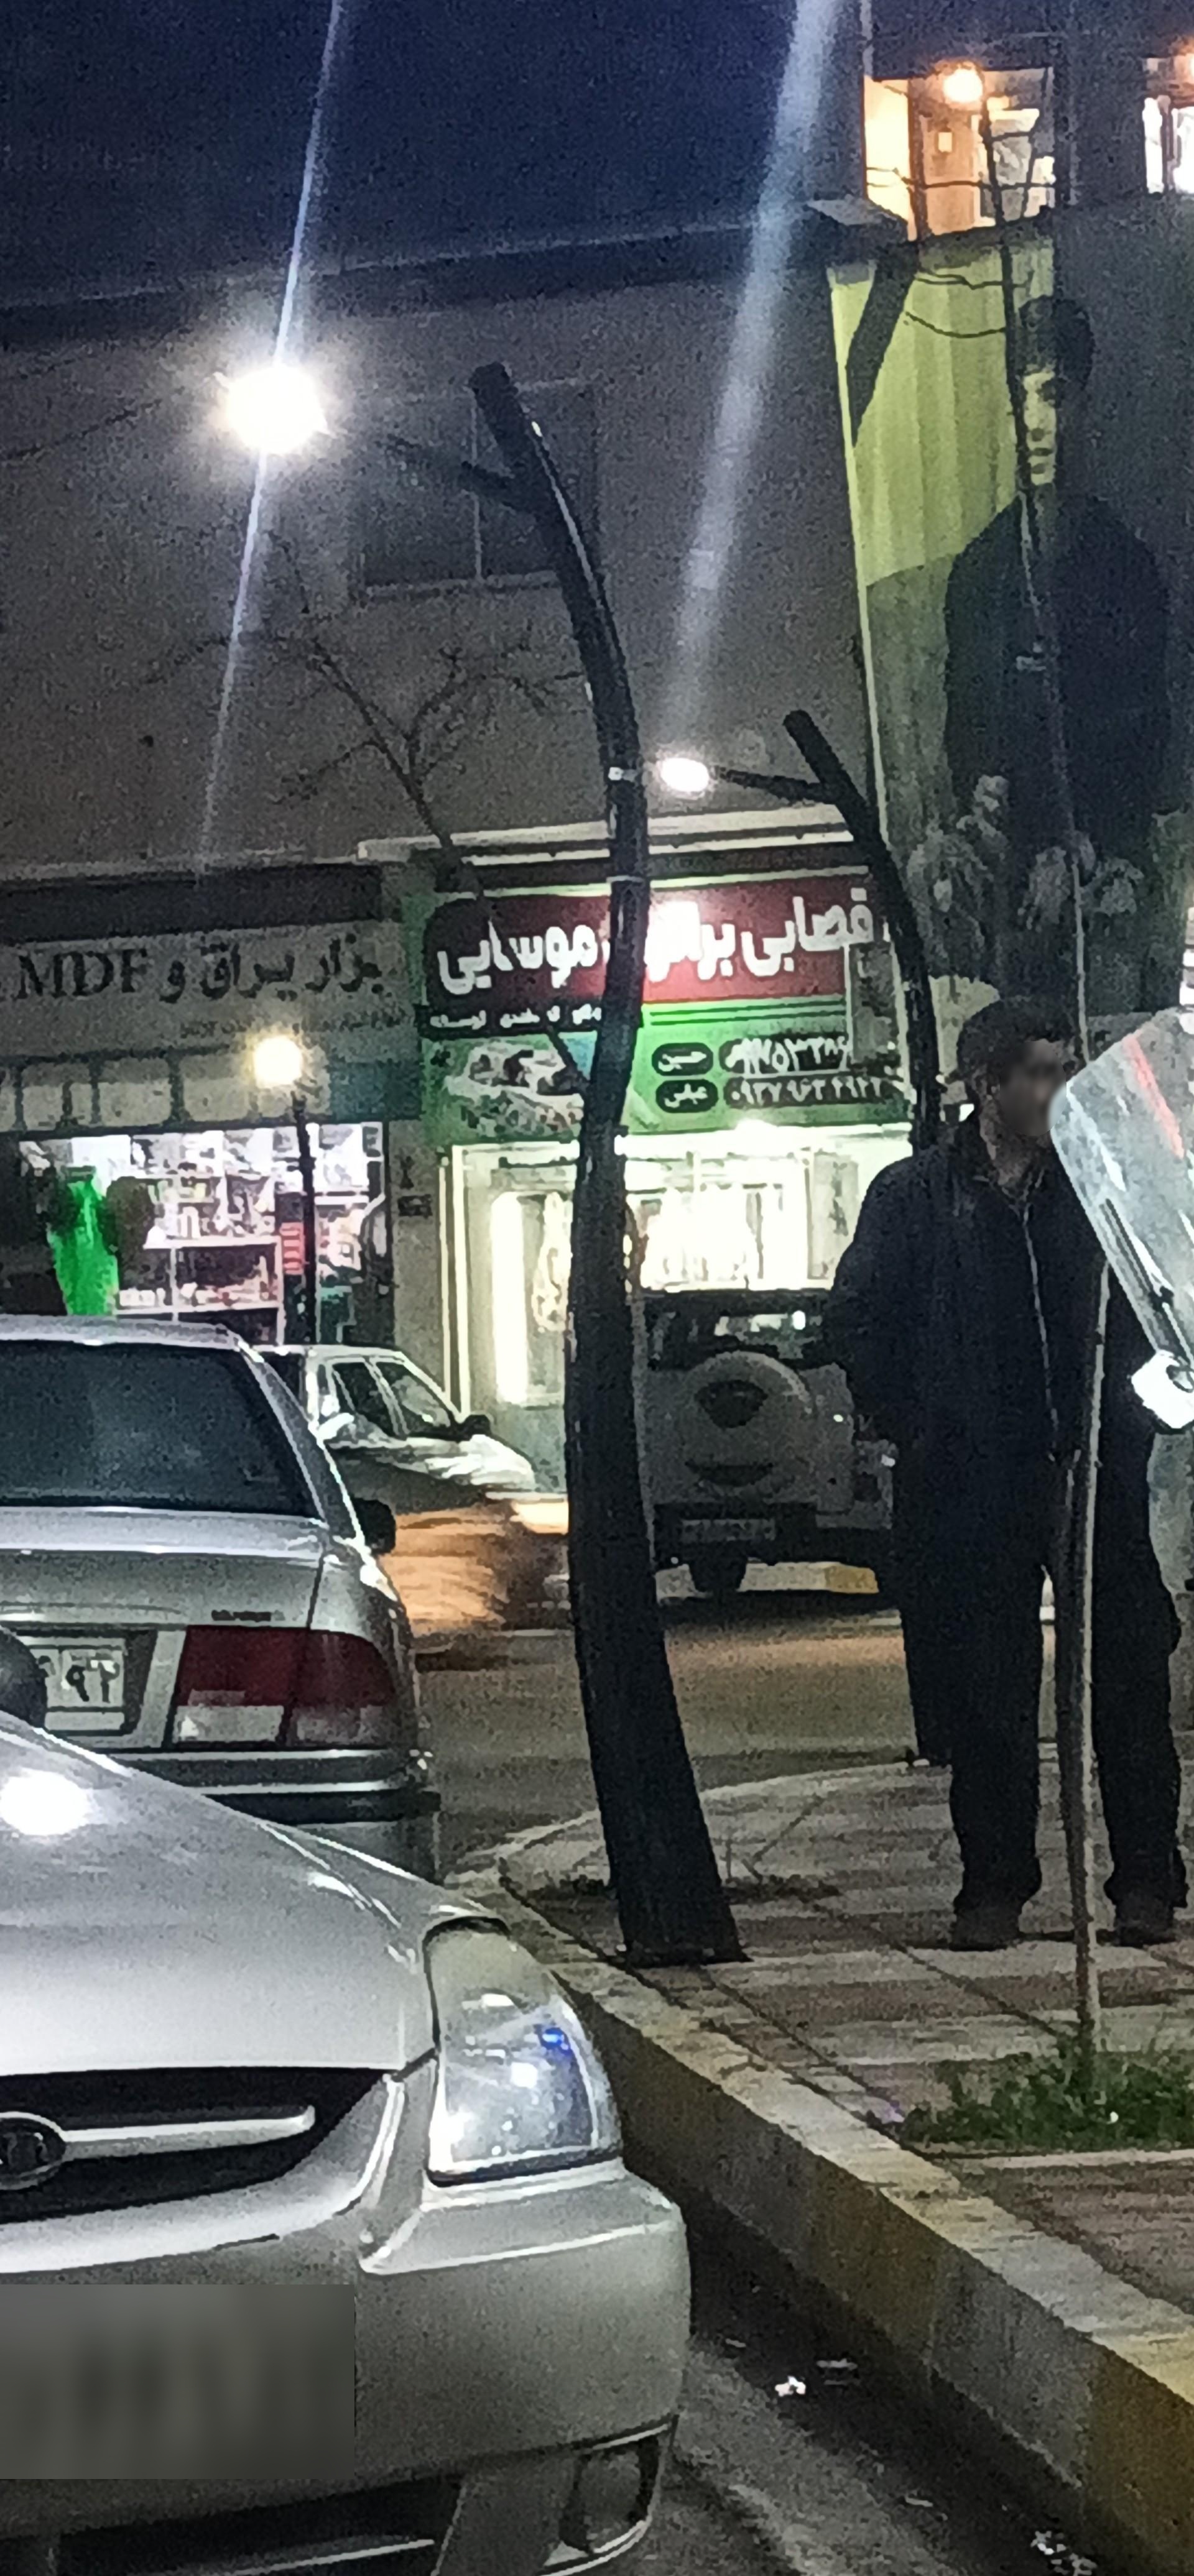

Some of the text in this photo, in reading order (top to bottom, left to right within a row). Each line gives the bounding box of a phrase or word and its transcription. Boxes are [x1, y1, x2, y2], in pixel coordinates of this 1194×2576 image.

[741, 887, 873, 977] قصابی
[11, 948, 148, 1000] MDF
[159, 960, 186, 1004] و
[664, 1082, 708, 1108] علی
